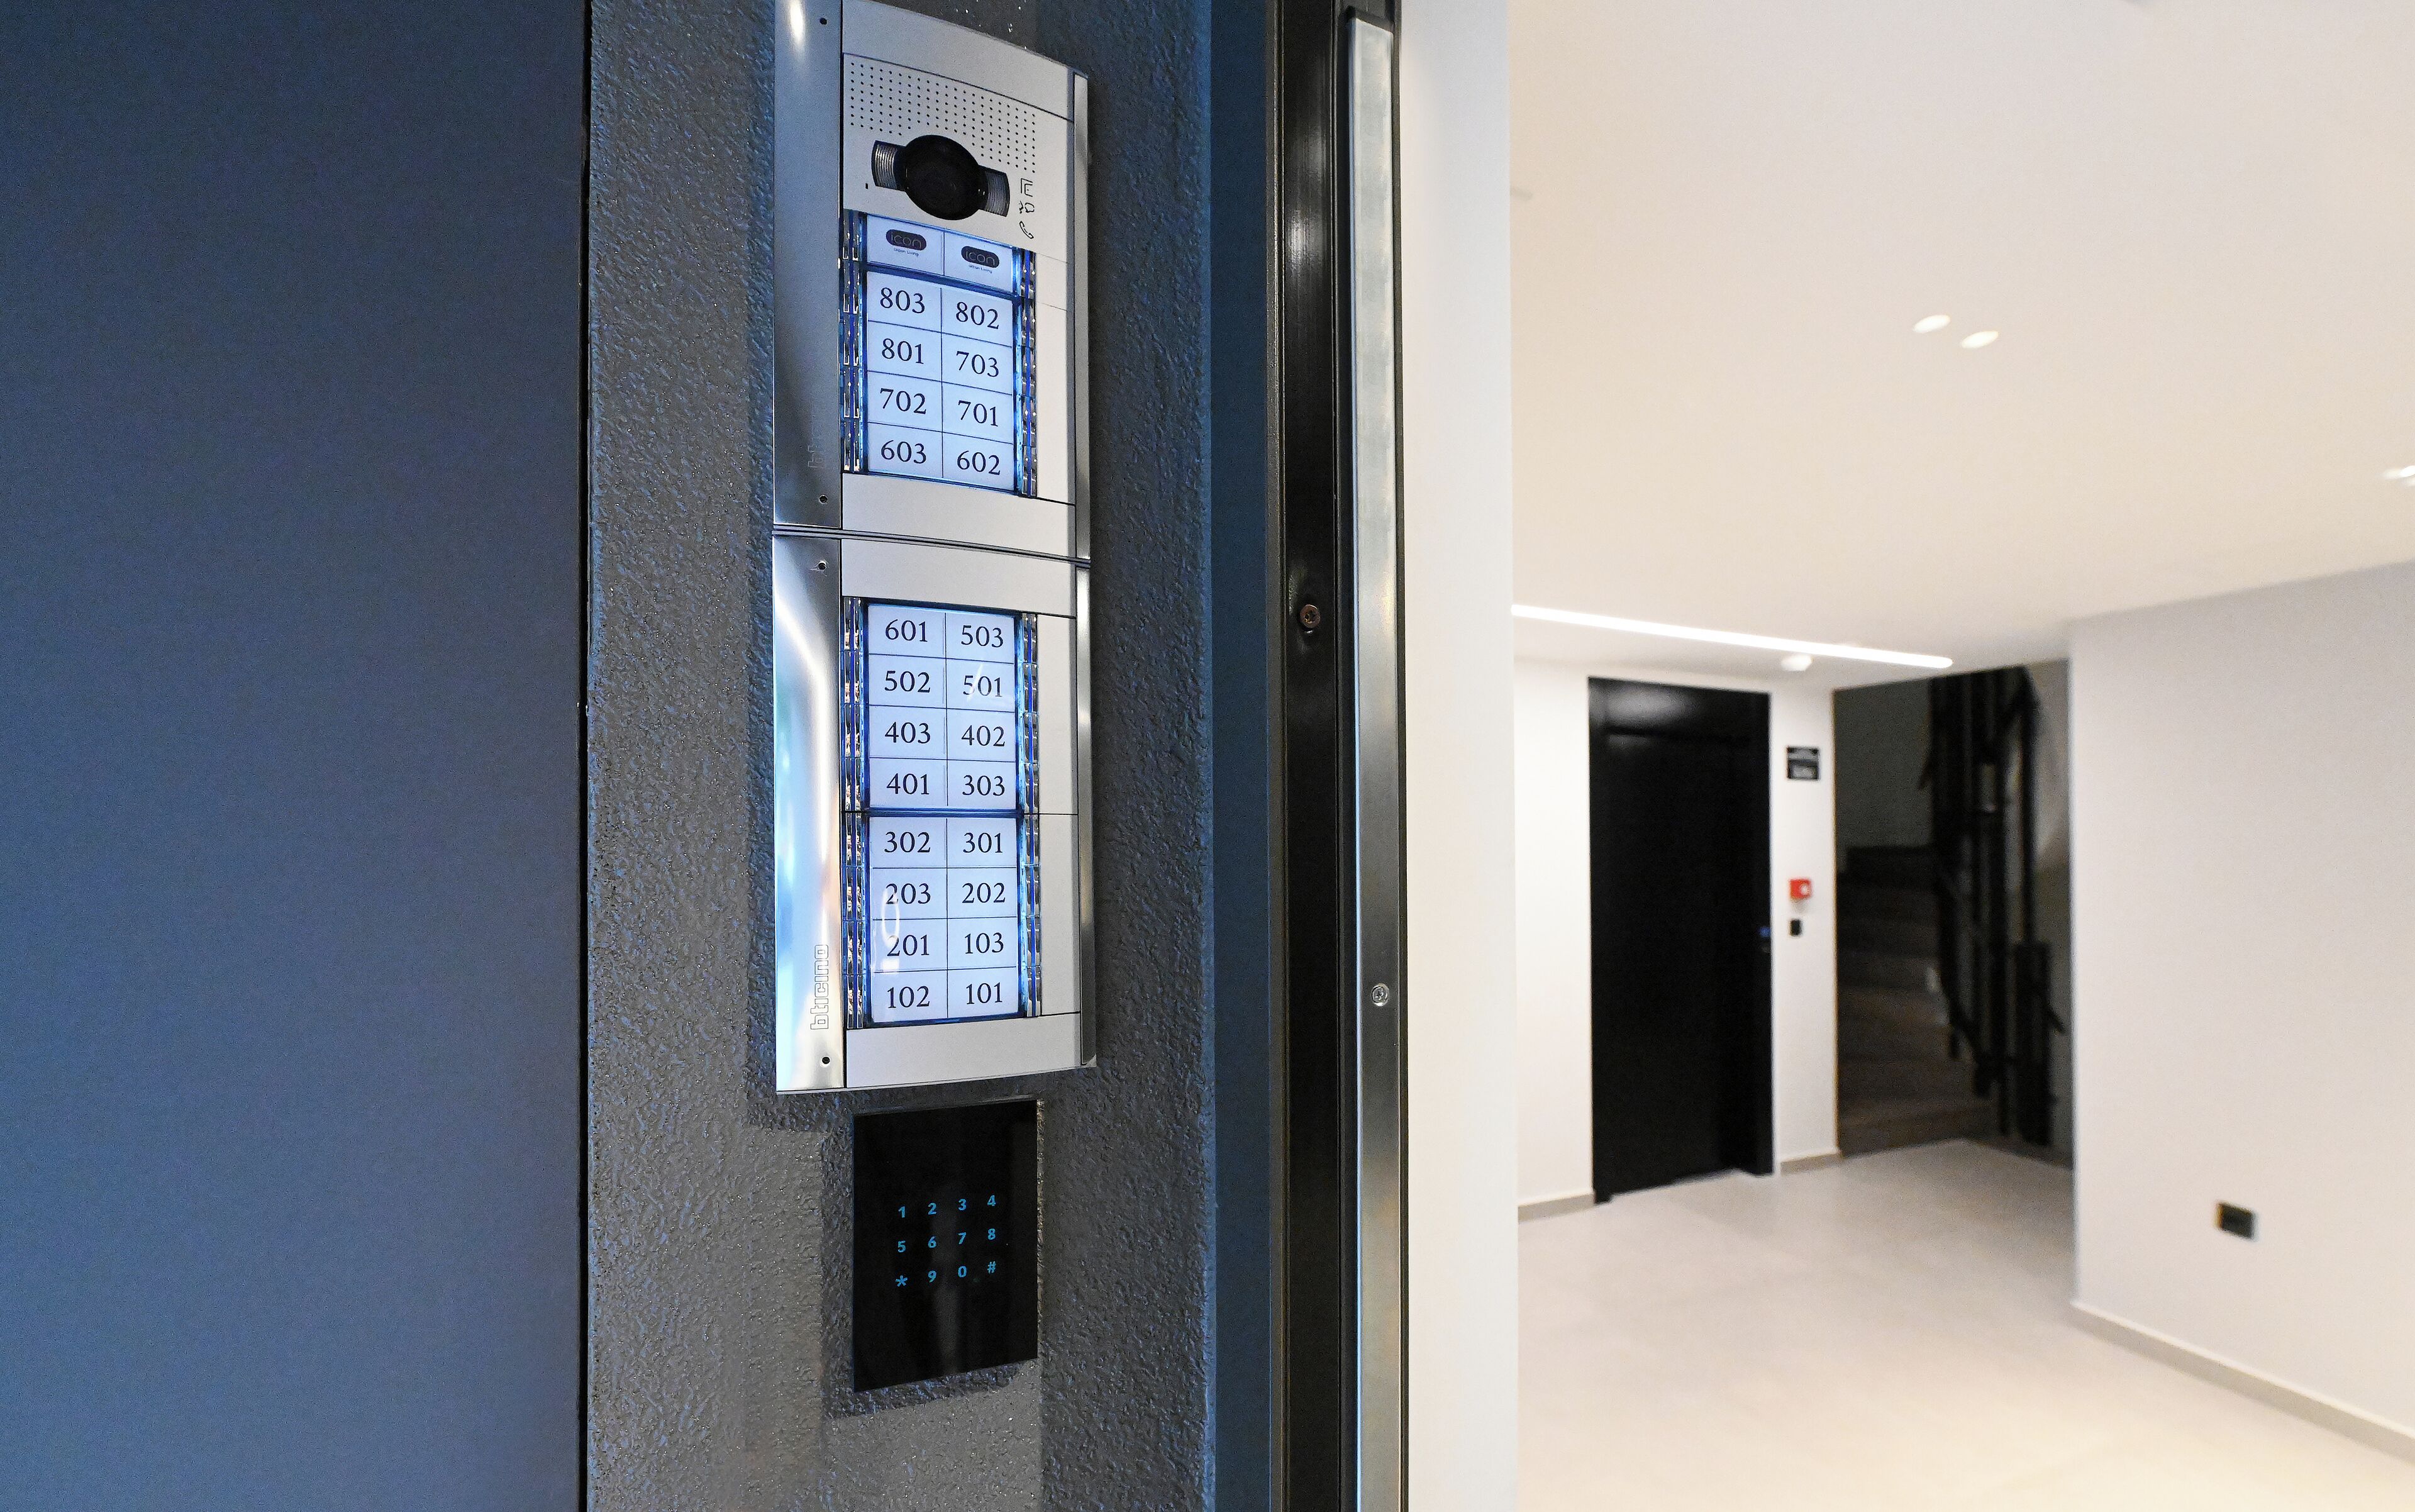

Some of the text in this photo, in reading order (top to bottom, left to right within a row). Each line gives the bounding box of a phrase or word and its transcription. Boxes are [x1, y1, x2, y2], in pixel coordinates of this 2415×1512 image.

[880, 287, 924, 313] 803
[956, 301, 999, 329] 802
[882, 338, 923, 364] 801
[957, 351, 999, 377] 703
[880, 388, 926, 414] 702
[958, 400, 998, 426] 701
[881, 440, 926, 464] 603
[957, 451, 1000, 475] 602
[886, 619, 928, 642] 601
[961, 625, 1003, 647] 503
[885, 670, 930, 692] 502
[963, 675, 1001, 697] 501
[885, 722, 930, 743] 403
[962, 725, 1005, 747] 402
[887, 773, 929, 794] 401
[962, 775, 1004, 796] 303
[884, 831, 930, 852] 302
[963, 833, 1002, 853] 301
[886, 883, 930, 904] 203
[962, 883, 1005, 903] 202
[887, 935, 929, 956] 201
[965, 933, 1003, 953] 103
[810, 944, 829, 1030] bticino
[887, 986, 930, 1008] 102
[966, 982, 1002, 1004] 101
[899, 1195, 996, 1218] 1 2 3 4
[898, 1228, 996, 1252] 5 6 7 8
[928, 1270, 936, 1282] 9
[958, 1266, 967, 1277] 0
